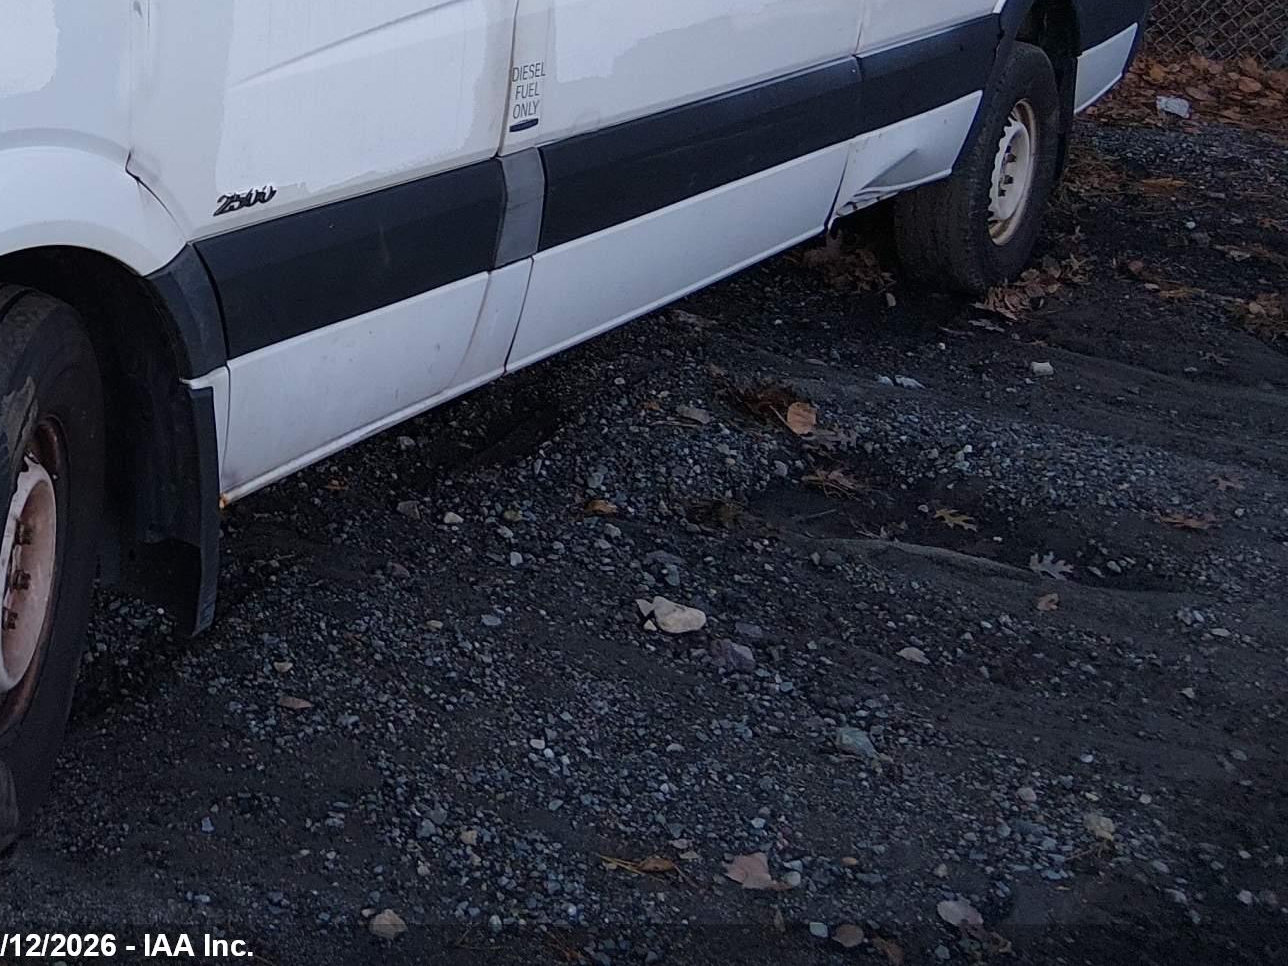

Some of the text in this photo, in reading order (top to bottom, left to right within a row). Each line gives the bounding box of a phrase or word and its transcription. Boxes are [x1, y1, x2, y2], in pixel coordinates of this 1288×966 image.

[512, 62, 546, 82] DIESEL
[515, 81, 540, 100] FUEL
[512, 100, 540, 119] ONLY
